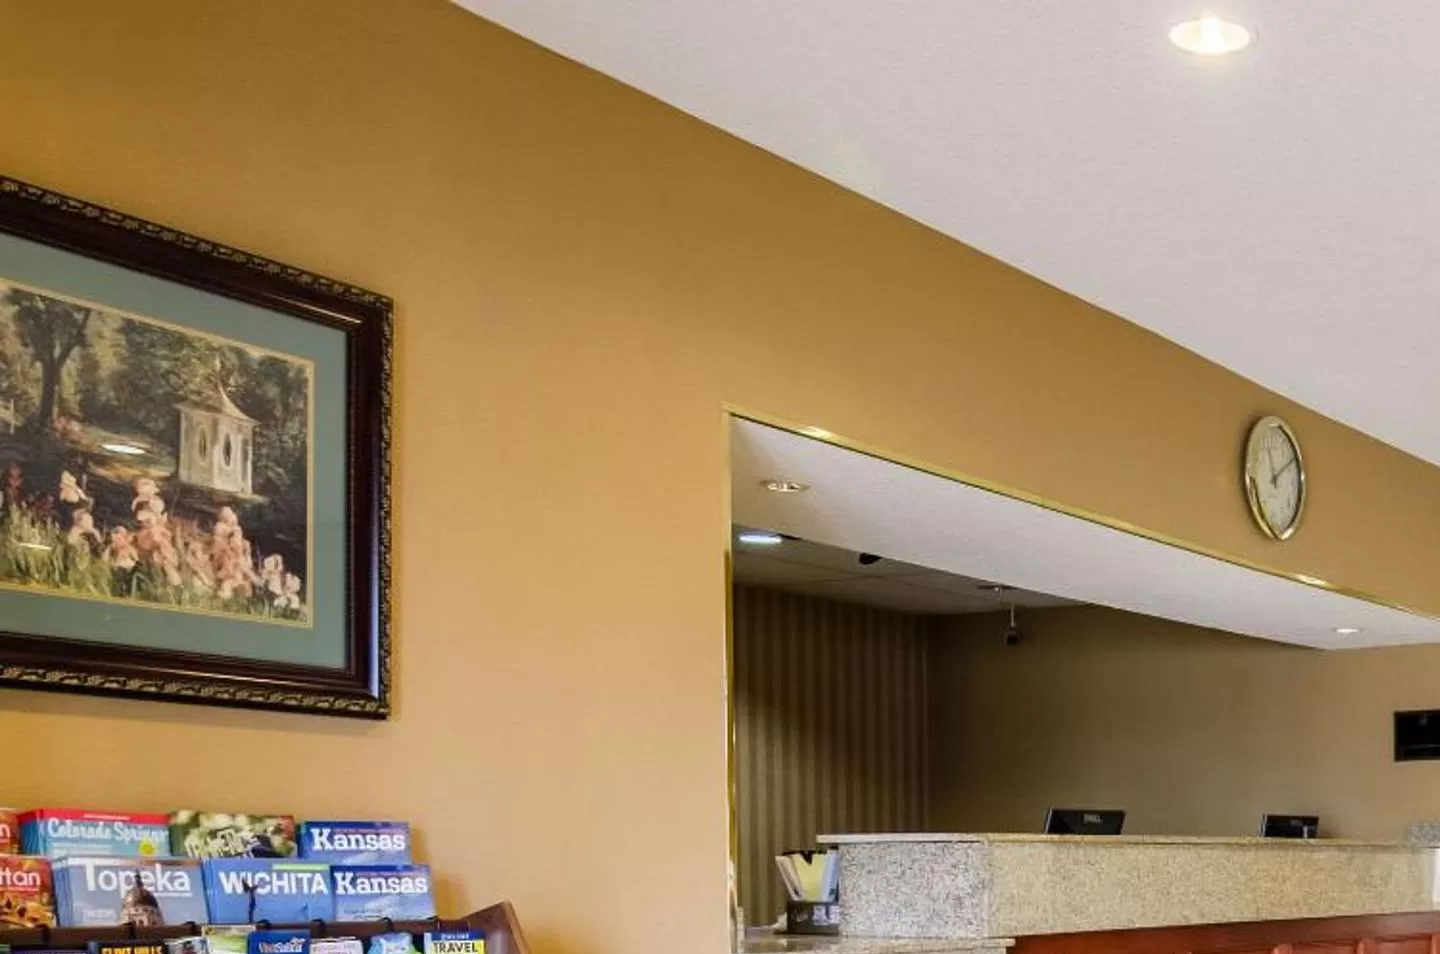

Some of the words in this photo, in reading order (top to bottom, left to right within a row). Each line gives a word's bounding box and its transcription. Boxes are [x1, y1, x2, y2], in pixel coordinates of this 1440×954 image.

[47, 817, 110, 839] Colorado
[310, 828, 406, 850] Kansas
[85, 863, 192, 898] Topeka
[218, 872, 329, 895] WICHITA
[333, 872, 429, 895] Kansas
[434, 942, 478, 953] TRAVEL
